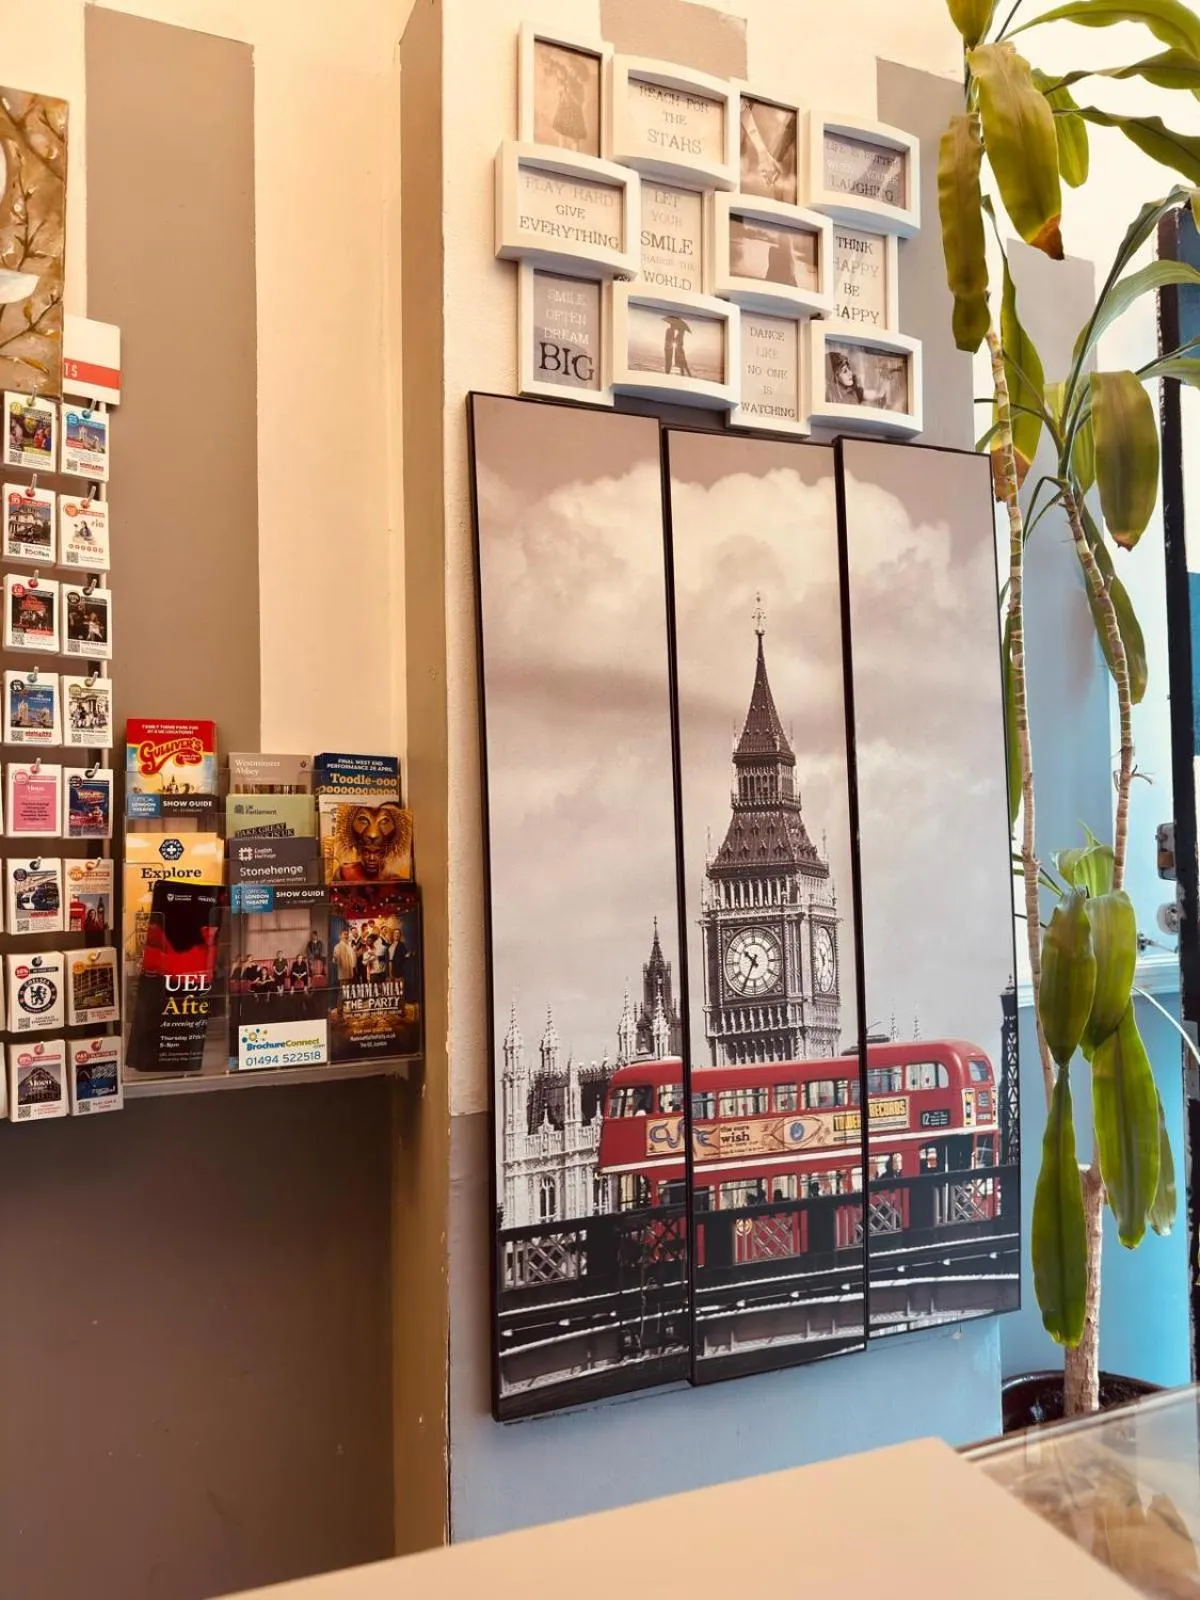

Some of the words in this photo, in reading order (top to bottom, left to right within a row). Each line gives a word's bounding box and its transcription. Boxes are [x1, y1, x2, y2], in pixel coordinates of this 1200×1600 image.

[640, 85, 680, 106] REACH
[686, 97, 710, 113] FOR
[663, 111, 687, 126] THE
[647, 128, 703, 155] STARS
[525, 176, 563, 195] PLAY
[572, 186, 614, 208] HARD
[830, 174, 896, 202] LAUGHIG
[655, 190, 680, 208] LET
[555, 204, 586, 219] GIVE
[652, 210, 683, 228] YOUR
[519, 215, 619, 250] EVERYTHING
[640, 230, 693, 256] SMILE
[836, 236, 873, 255] THINK
[643, 269, 692, 292] WORLD
[547, 288, 586, 306] SMILE
[844, 282, 860, 297] BE
[544, 327, 589, 346] DREAM
[750, 327, 785, 342] DANCE
[539, 342, 595, 381] BIG
[747, 364, 762, 376] NO
[766, 367, 788, 380] ONE
[762, 385, 773, 396] IS
[740, 401, 796, 418] WATCHING
[235, 759, 281, 767] Westminster
[327, 763, 368, 771] PERFORMANCE
[236, 767, 259, 776] Abbey
[330, 772, 397, 786] Toodle-ooo
[162, 800, 186, 808] SHOW
[141, 867, 202, 879] Explore
[240, 866, 304, 877] Stonehenge
[164, 974, 212, 992] UEL
[344, 1000, 363, 1010] THE
[368, 997, 400, 1008] PARTY
[246, 1038, 320, 1051] BrochureConnect
[246, 1055, 279, 1066] 01494
[282, 1051, 321, 1063] 522518
[721, 1131, 750, 1143] wish
